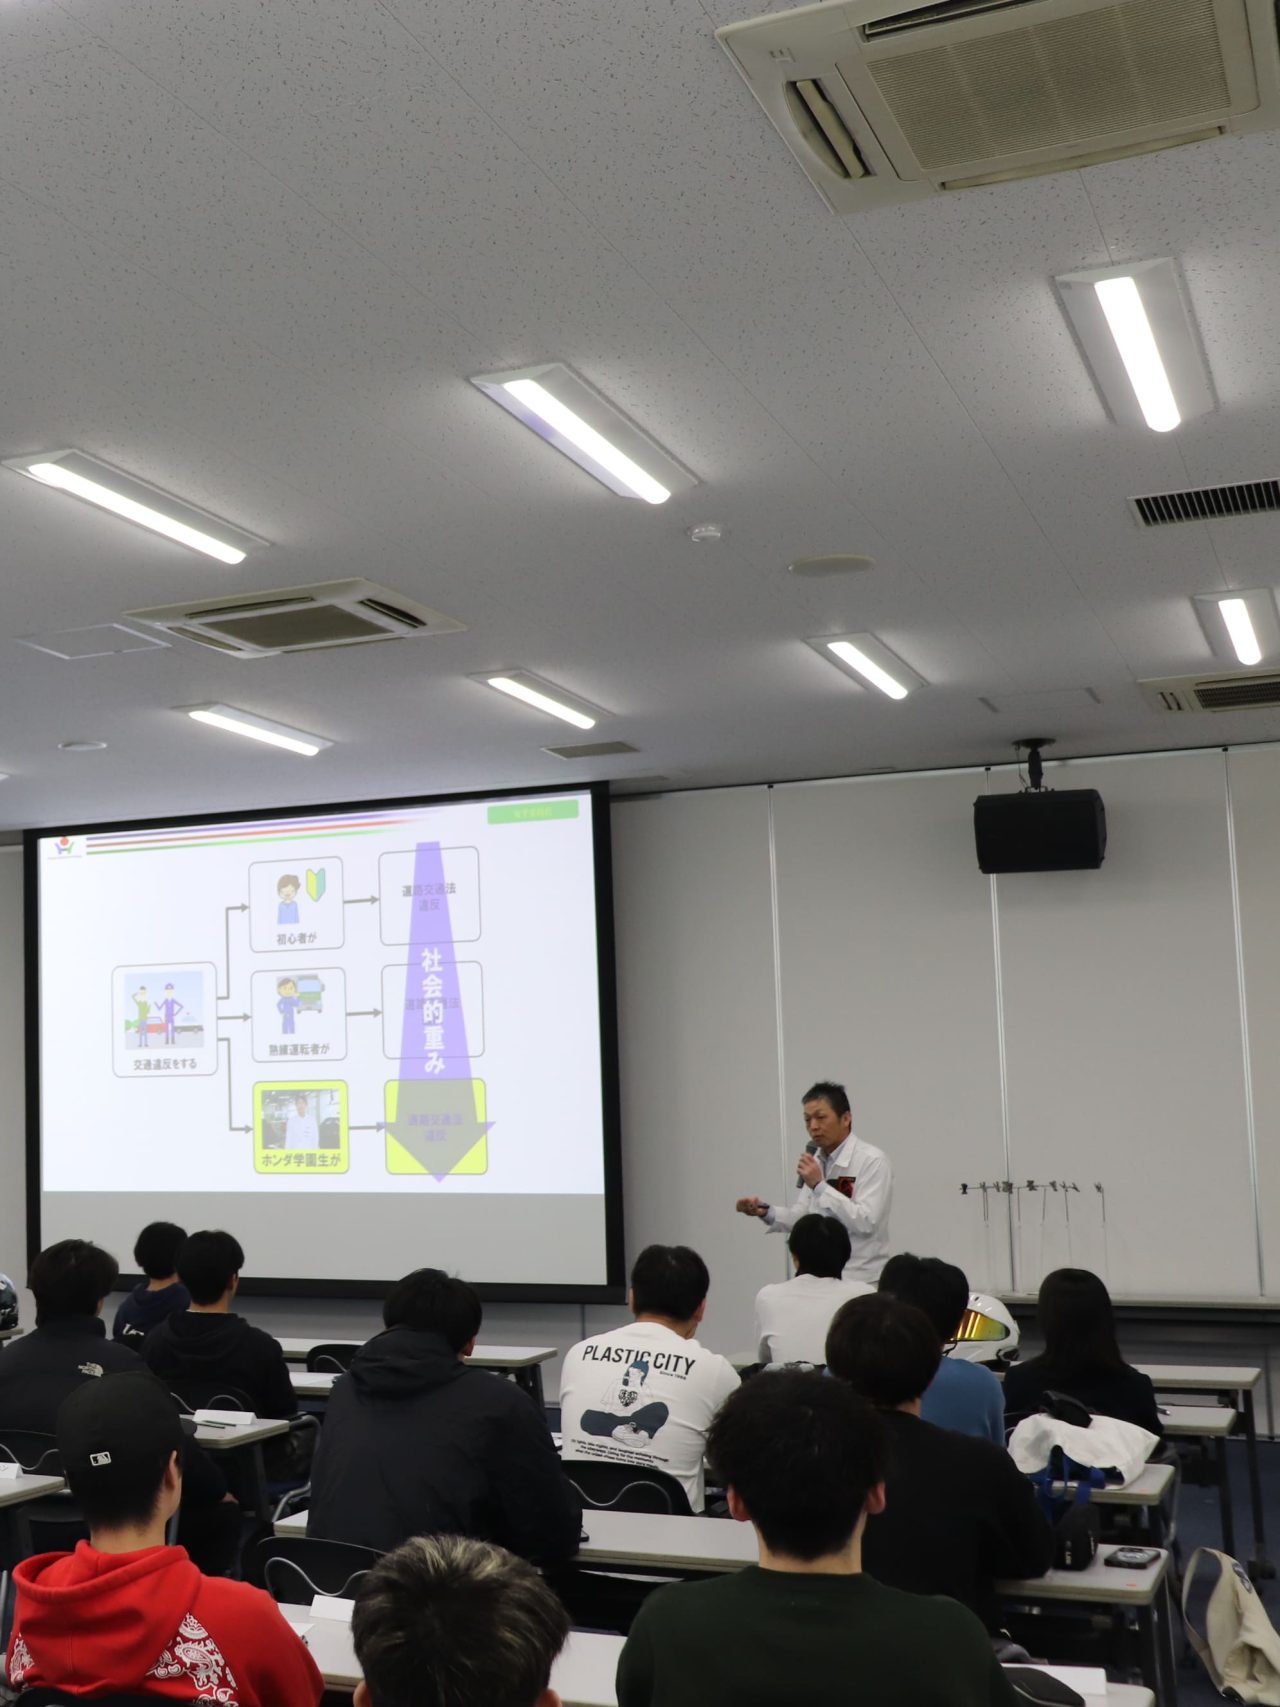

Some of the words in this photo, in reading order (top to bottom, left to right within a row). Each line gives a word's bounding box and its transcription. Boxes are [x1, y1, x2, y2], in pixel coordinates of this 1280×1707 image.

[276, 931, 318, 946] 初心者が
[421, 947, 445, 1075] 社会的重み
[268, 1043, 331, 1057] 熟練運転者が
[133, 1058, 198, 1071] 交通違反をする
[261, 1152, 341, 1168] ホンダ学園生が
[582, 1344, 651, 1365] PLASTIC
[653, 1352, 696, 1376] CITY
